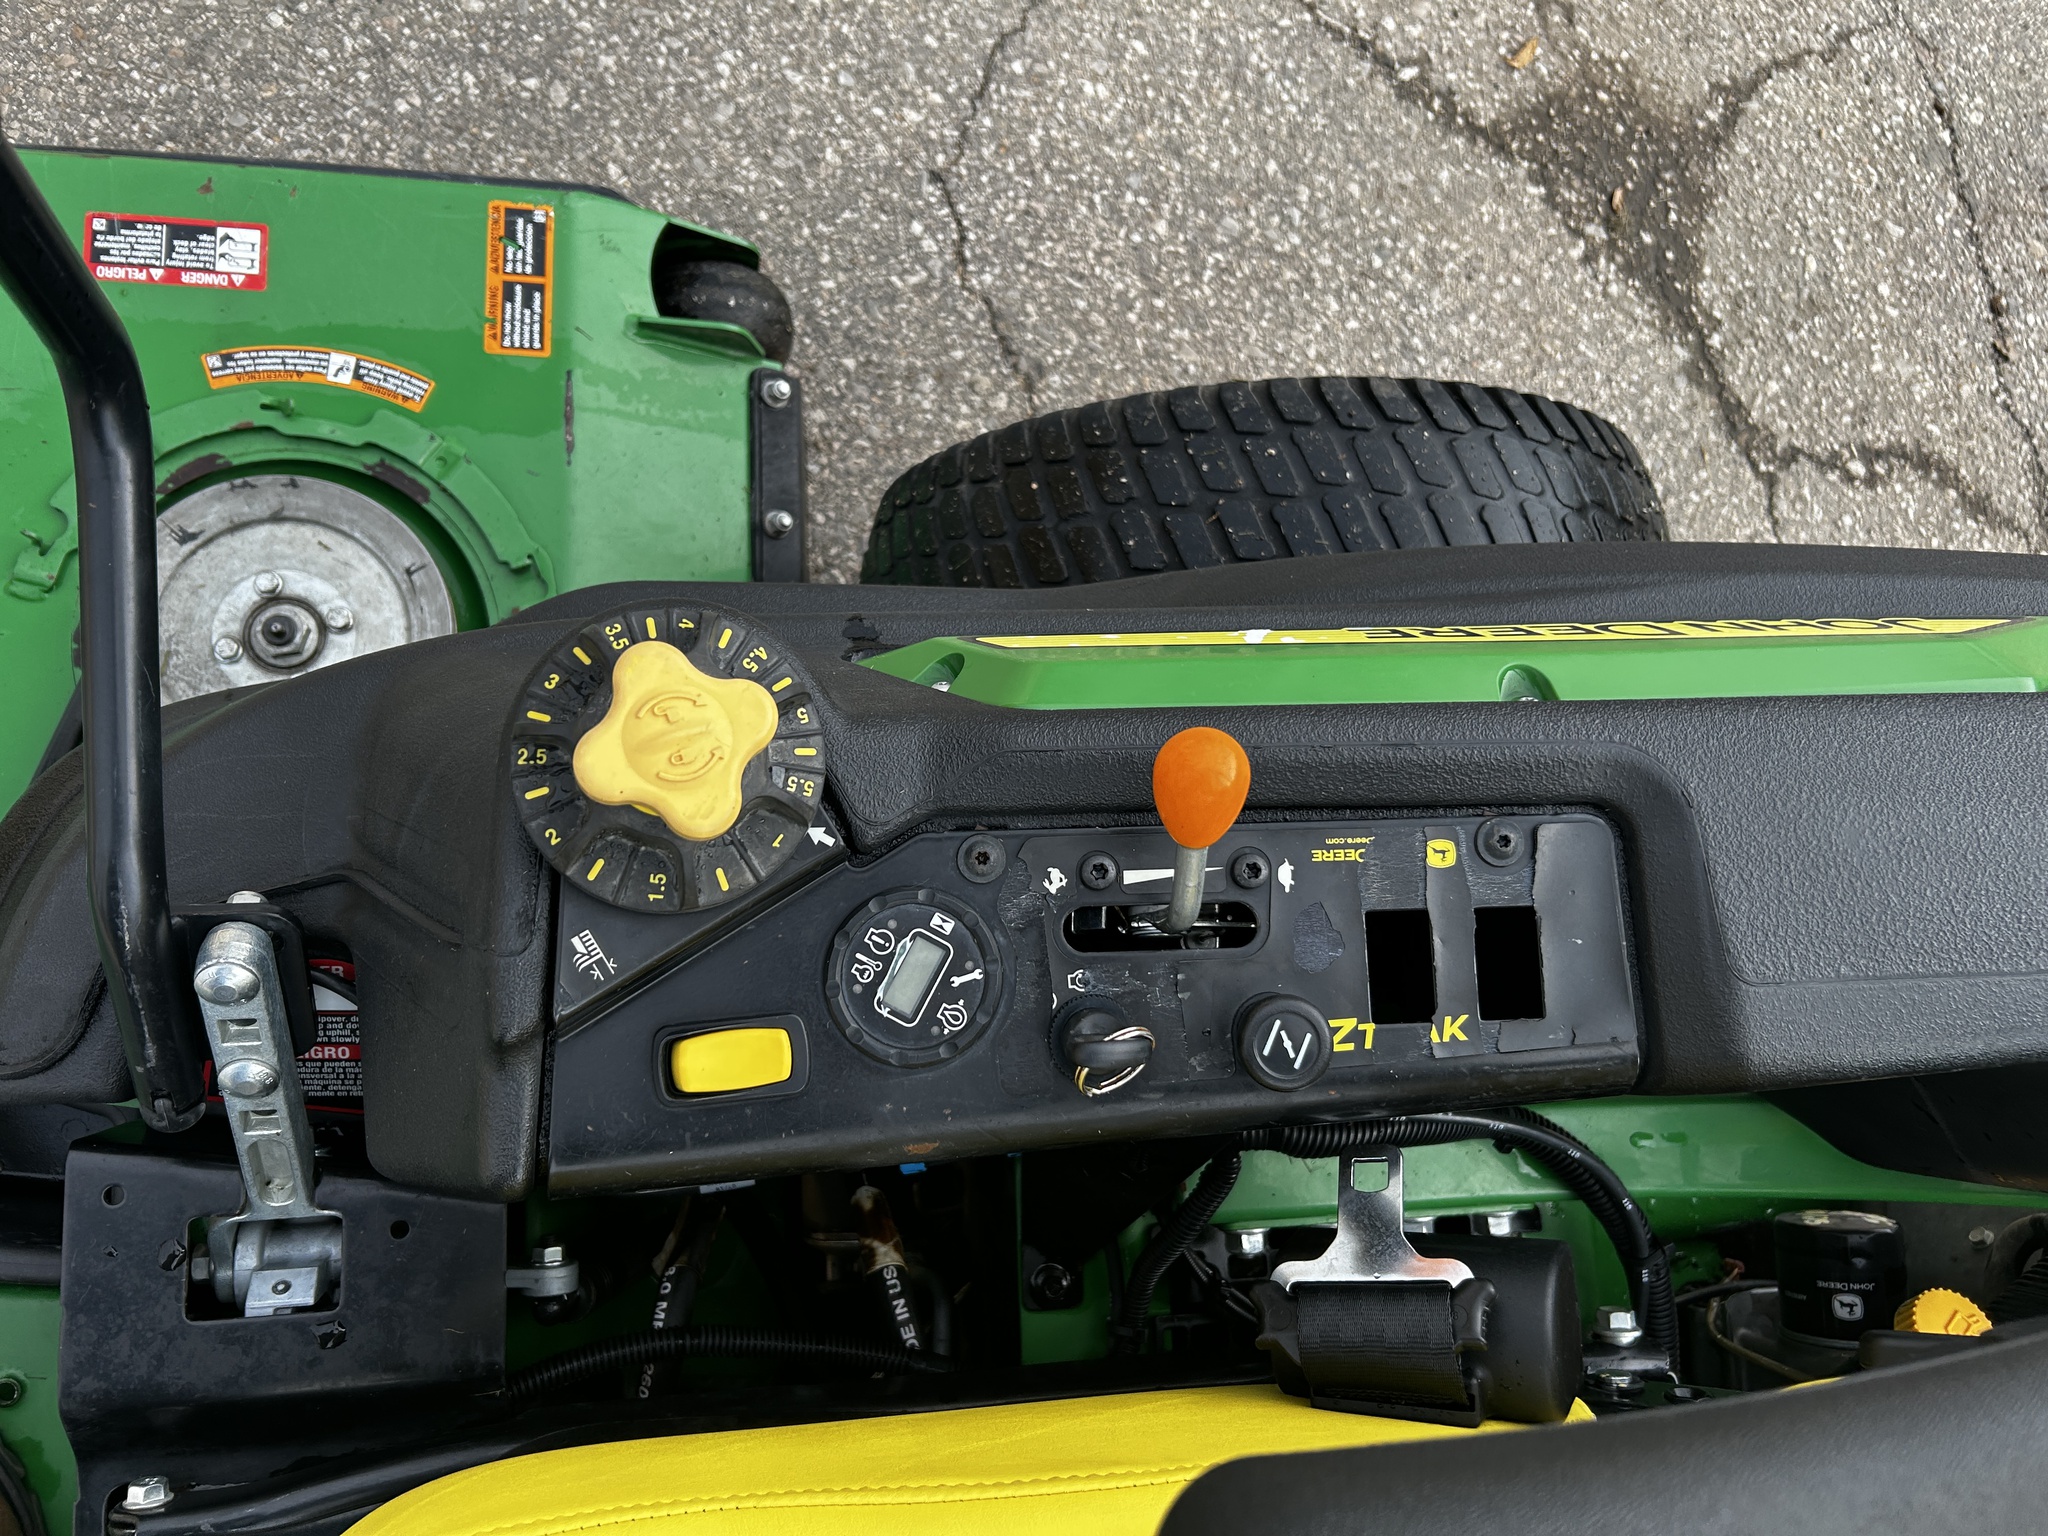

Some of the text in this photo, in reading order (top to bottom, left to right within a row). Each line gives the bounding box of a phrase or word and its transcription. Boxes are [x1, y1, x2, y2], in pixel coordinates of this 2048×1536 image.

[96, 265, 147, 280] PELIGRO
[181, 271, 228, 286] DANGER
[236, 372, 295, 381] ADVERTENCIA
[678, 618, 695, 630] 4
[1365, 619, 1936, 639] JOHN DEERE
[605, 623, 630, 650] 3.5
[742, 646, 768, 673] 4.5
[544, 673, 560, 690] 3
[796, 707, 809, 724] 5
[517, 748, 547, 765] 2.5
[787, 775, 815, 798] 5.5
[544, 828, 562, 846] 2
[772, 833, 785, 848] 1
[647, 873, 667, 901] 1.5
[1816, 1280, 1875, 1291] JOHN DEERE
[892, 1298, 910, 1320] IN
